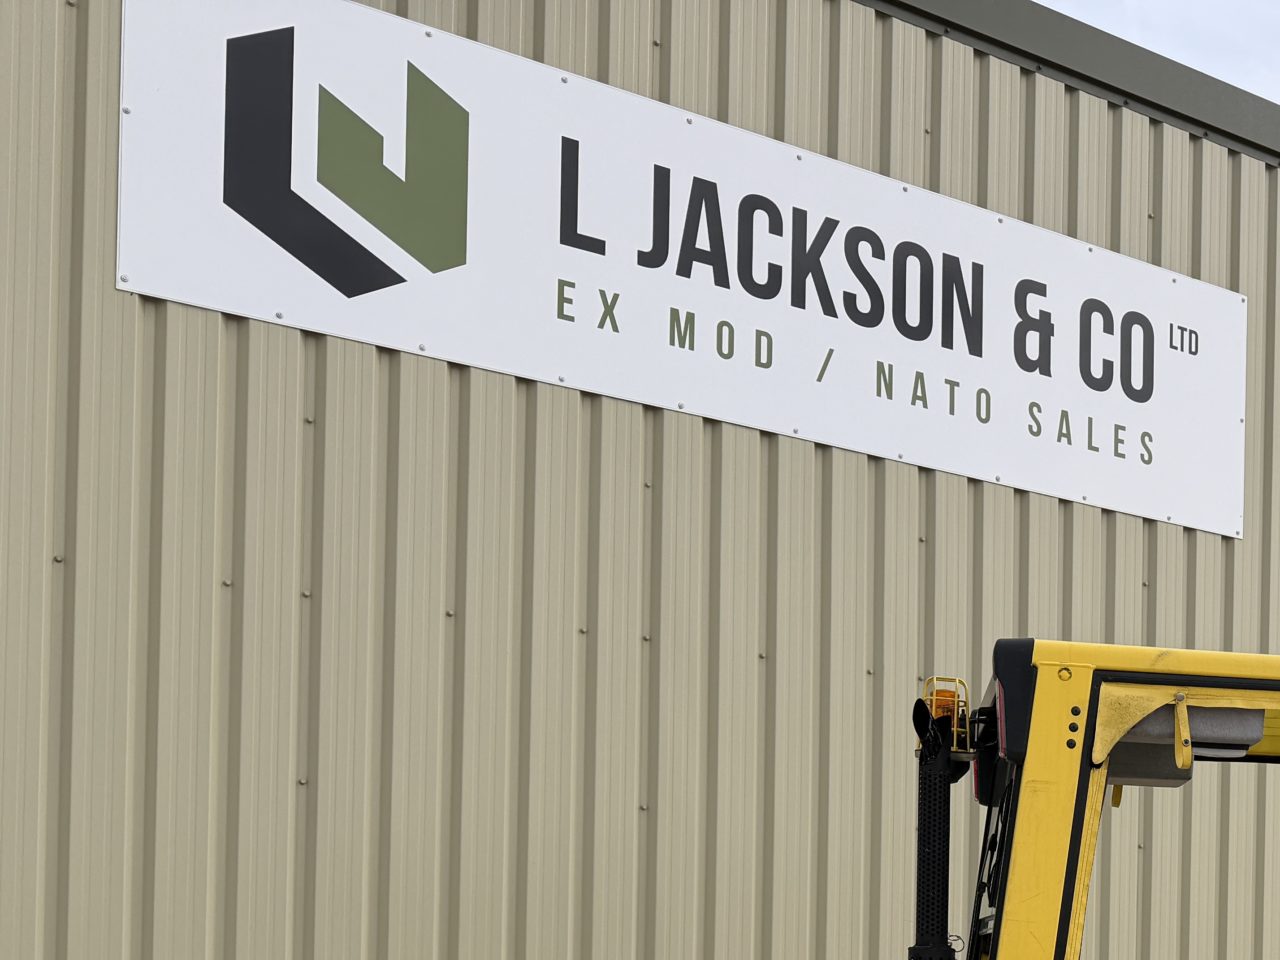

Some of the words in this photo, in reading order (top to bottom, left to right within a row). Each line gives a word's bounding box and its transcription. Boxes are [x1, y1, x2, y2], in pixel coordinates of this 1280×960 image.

[556, 278, 620, 334] EX
[669, 306, 774, 369] MOD
[816, 348, 835, 383] /
[876, 360, 993, 425] NATO
[1027, 401, 1155, 466] SALES
[559, 135, 607, 257] L
[637, 163, 985, 359] JACKSON
[1013, 278, 1055, 378] &
[1078, 297, 1156, 404] CO
[1169, 322, 1199, 356] LTD
